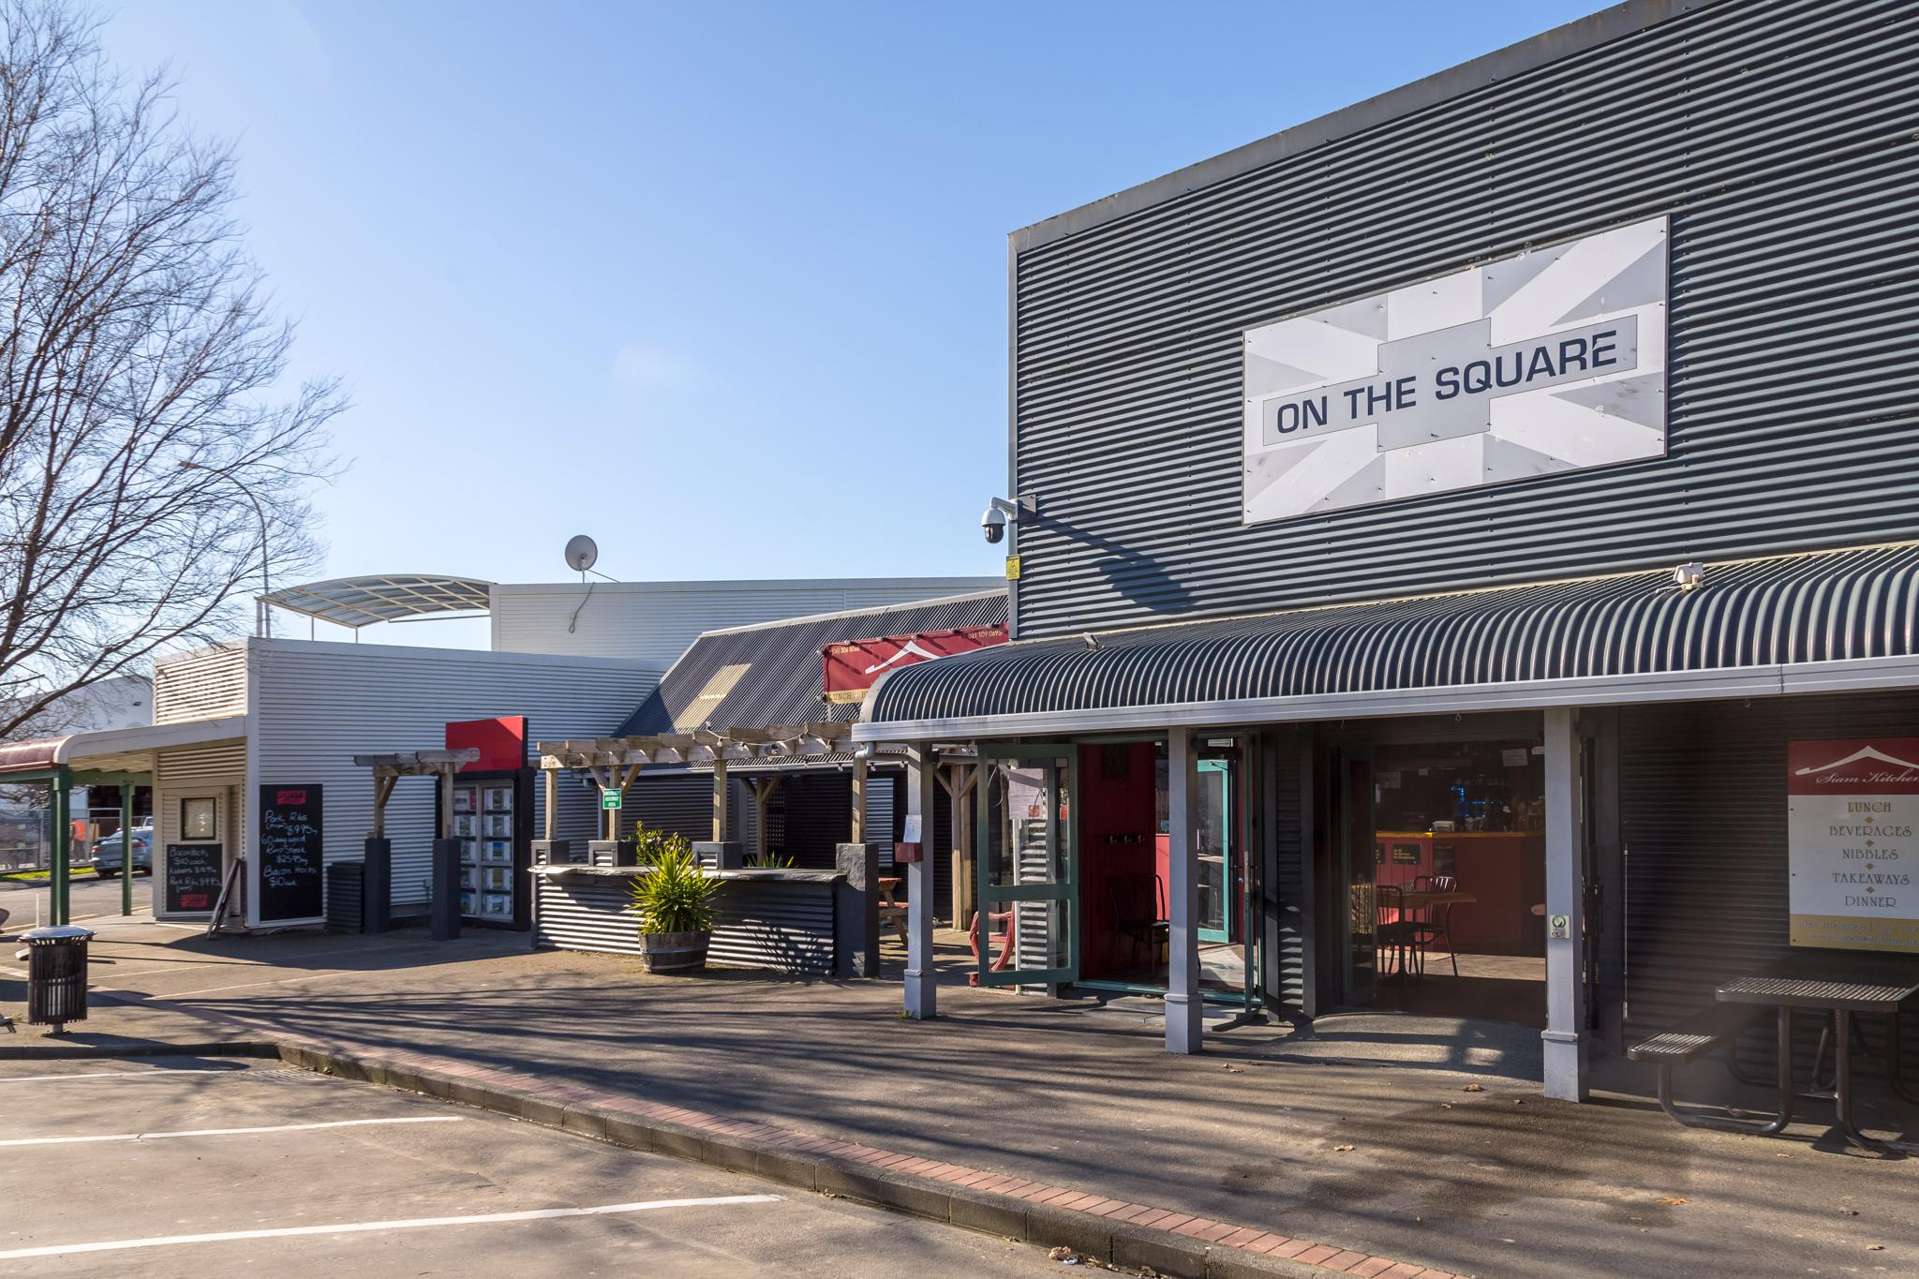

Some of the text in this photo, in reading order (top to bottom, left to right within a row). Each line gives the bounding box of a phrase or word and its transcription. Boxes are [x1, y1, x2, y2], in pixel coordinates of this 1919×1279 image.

[1276, 330, 1618, 434] ON THE SQUARE
[1816, 772, 1859, 784] Siam
[1847, 801, 1891, 813] LUNCH
[1829, 825, 1912, 837] BEVERAGES
[1842, 848, 1899, 860] NIBBLES
[1832, 872, 1910, 885] TAKEAWAYS
[1845, 895, 1897, 908] DINNER
